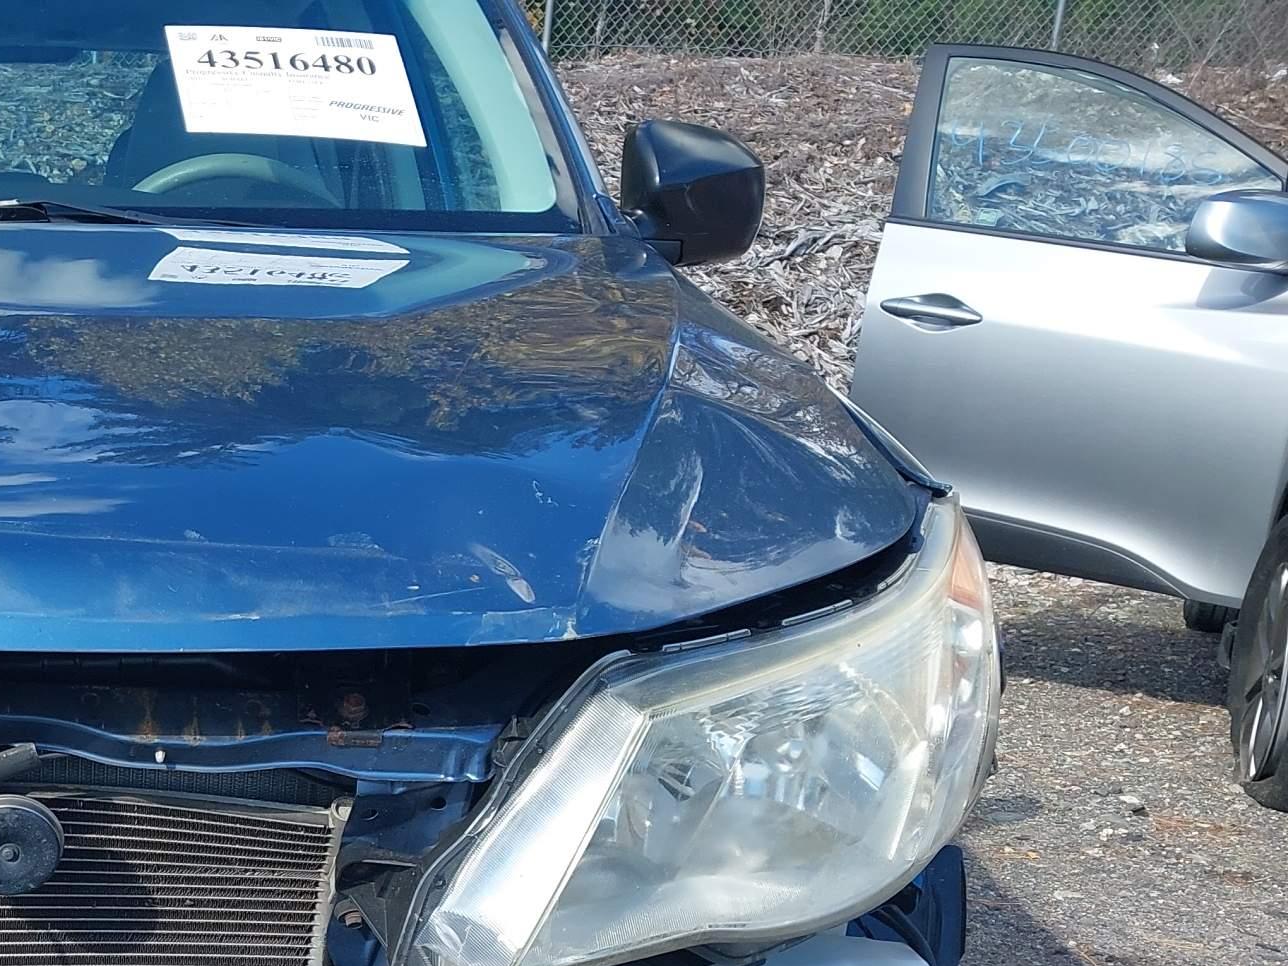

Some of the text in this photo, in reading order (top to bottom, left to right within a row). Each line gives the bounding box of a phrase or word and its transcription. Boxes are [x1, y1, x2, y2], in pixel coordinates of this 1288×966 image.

[196, 49, 377, 76] 43516480
[329, 100, 406, 117] PROGRESSIVE
[360, 114, 379, 122] VIC
